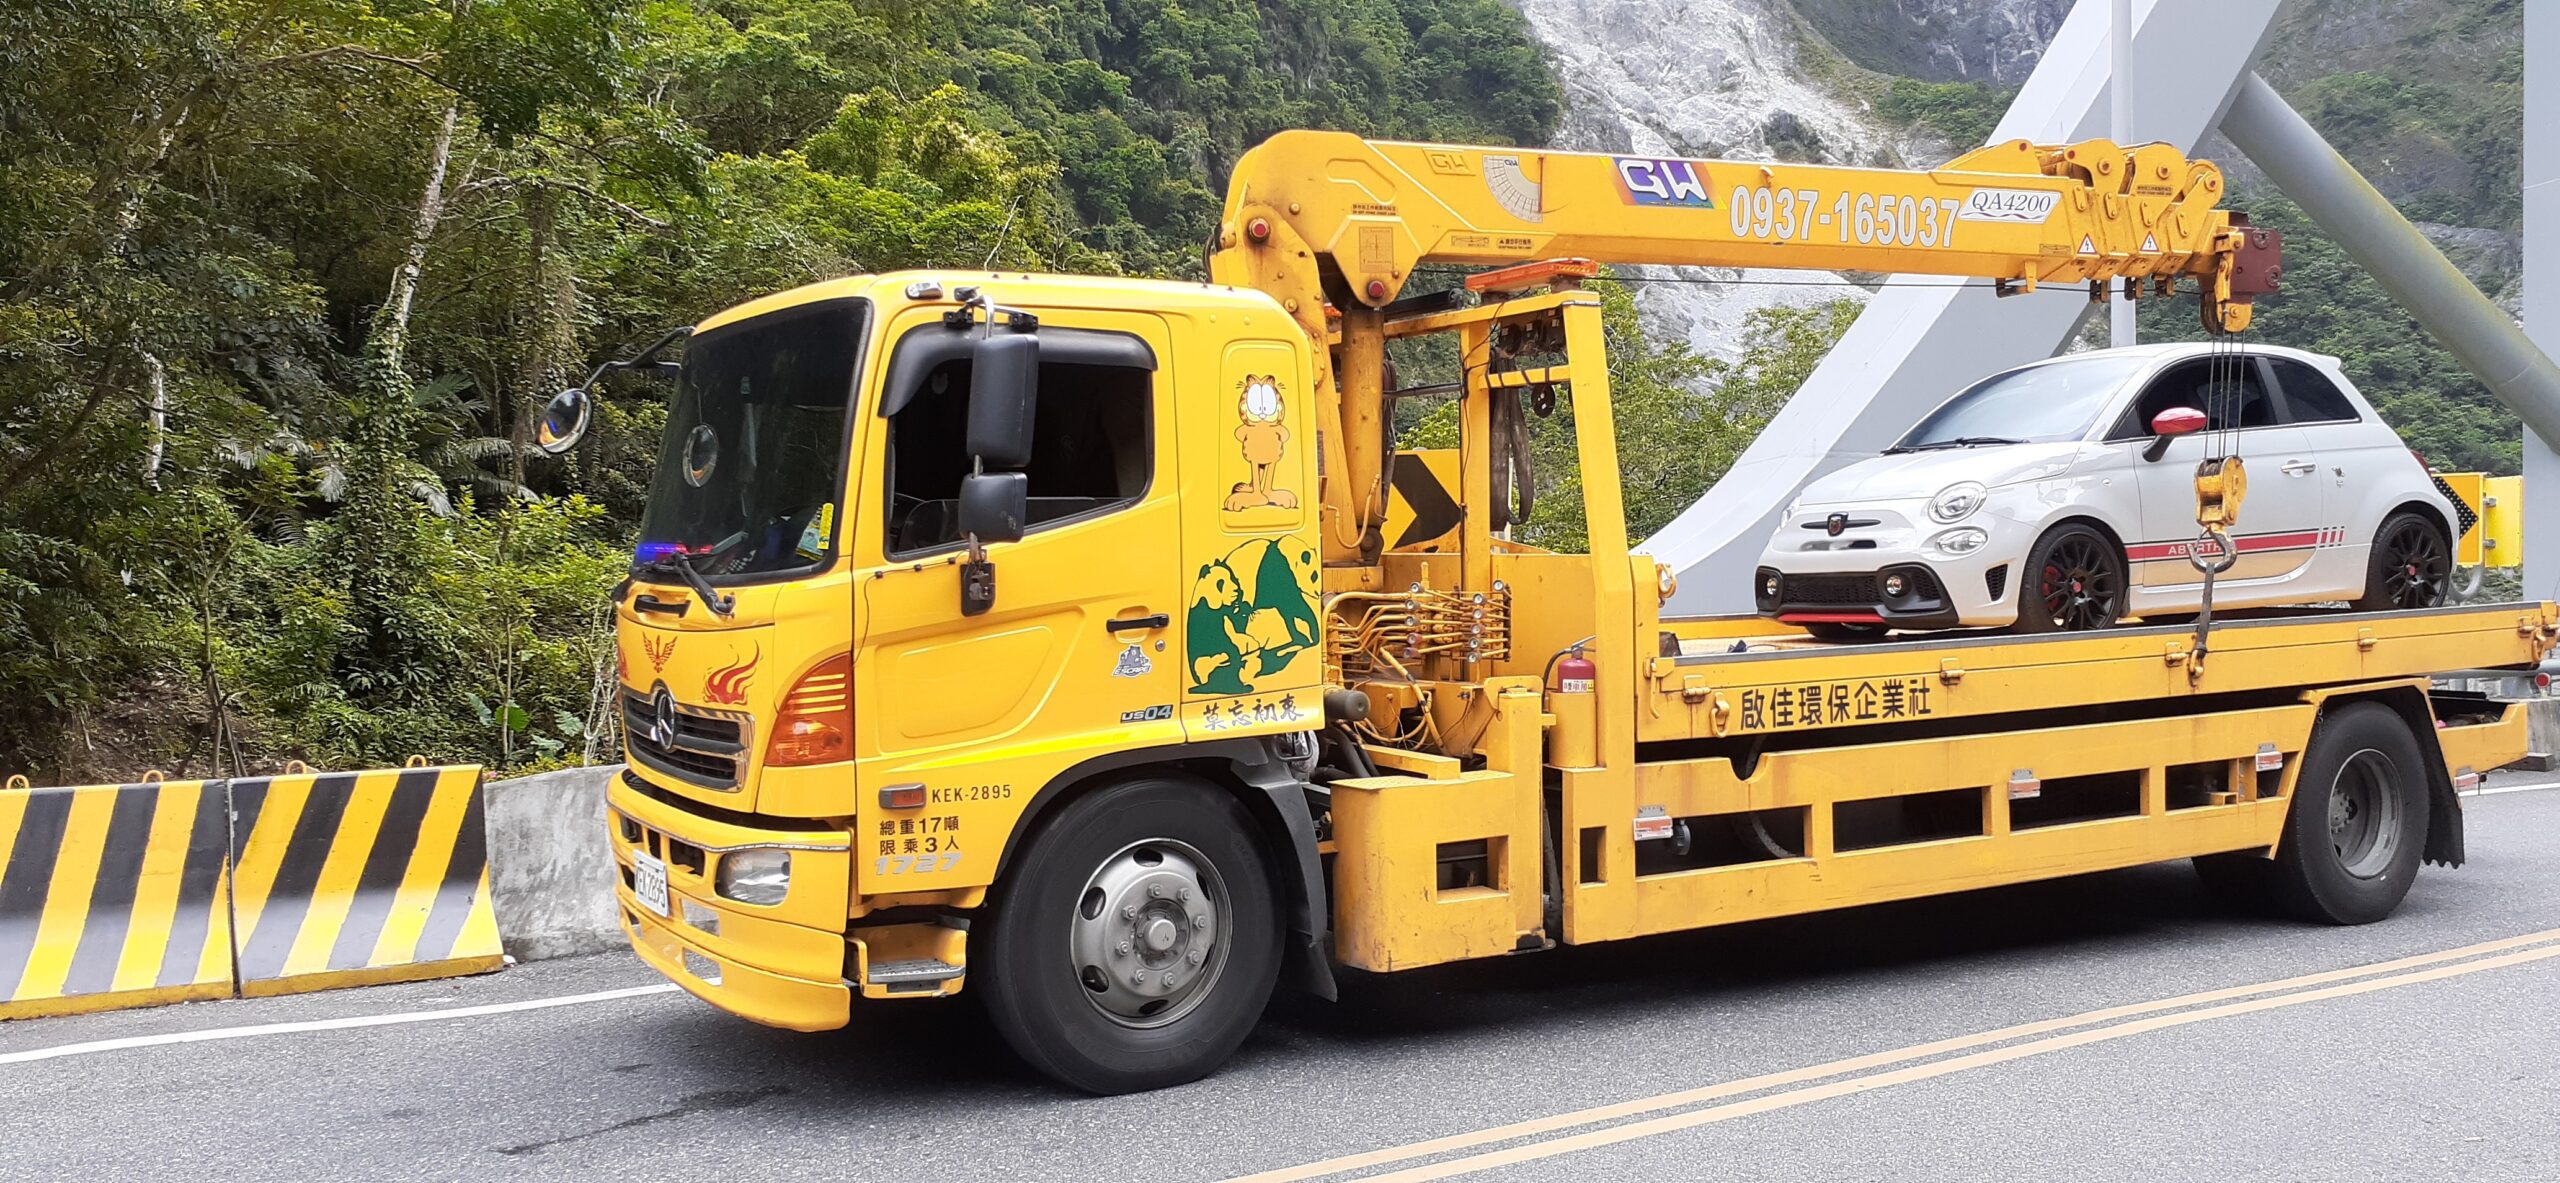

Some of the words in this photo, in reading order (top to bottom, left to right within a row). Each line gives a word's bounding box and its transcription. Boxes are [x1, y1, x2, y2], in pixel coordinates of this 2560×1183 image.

[1619, 159, 1708, 200] GW
[1972, 191, 2051, 212] QA4200
[1730, 185, 1960, 248] 0937-165037
[2168, 543, 2222, 555] ABRTH
[1203, 693, 1304, 731] 莫忘初衷
[932, 784, 1011, 803] KEK-2895
[880, 836, 960, 856] 限乘3人
[875, 852, 962, 876] 1727
